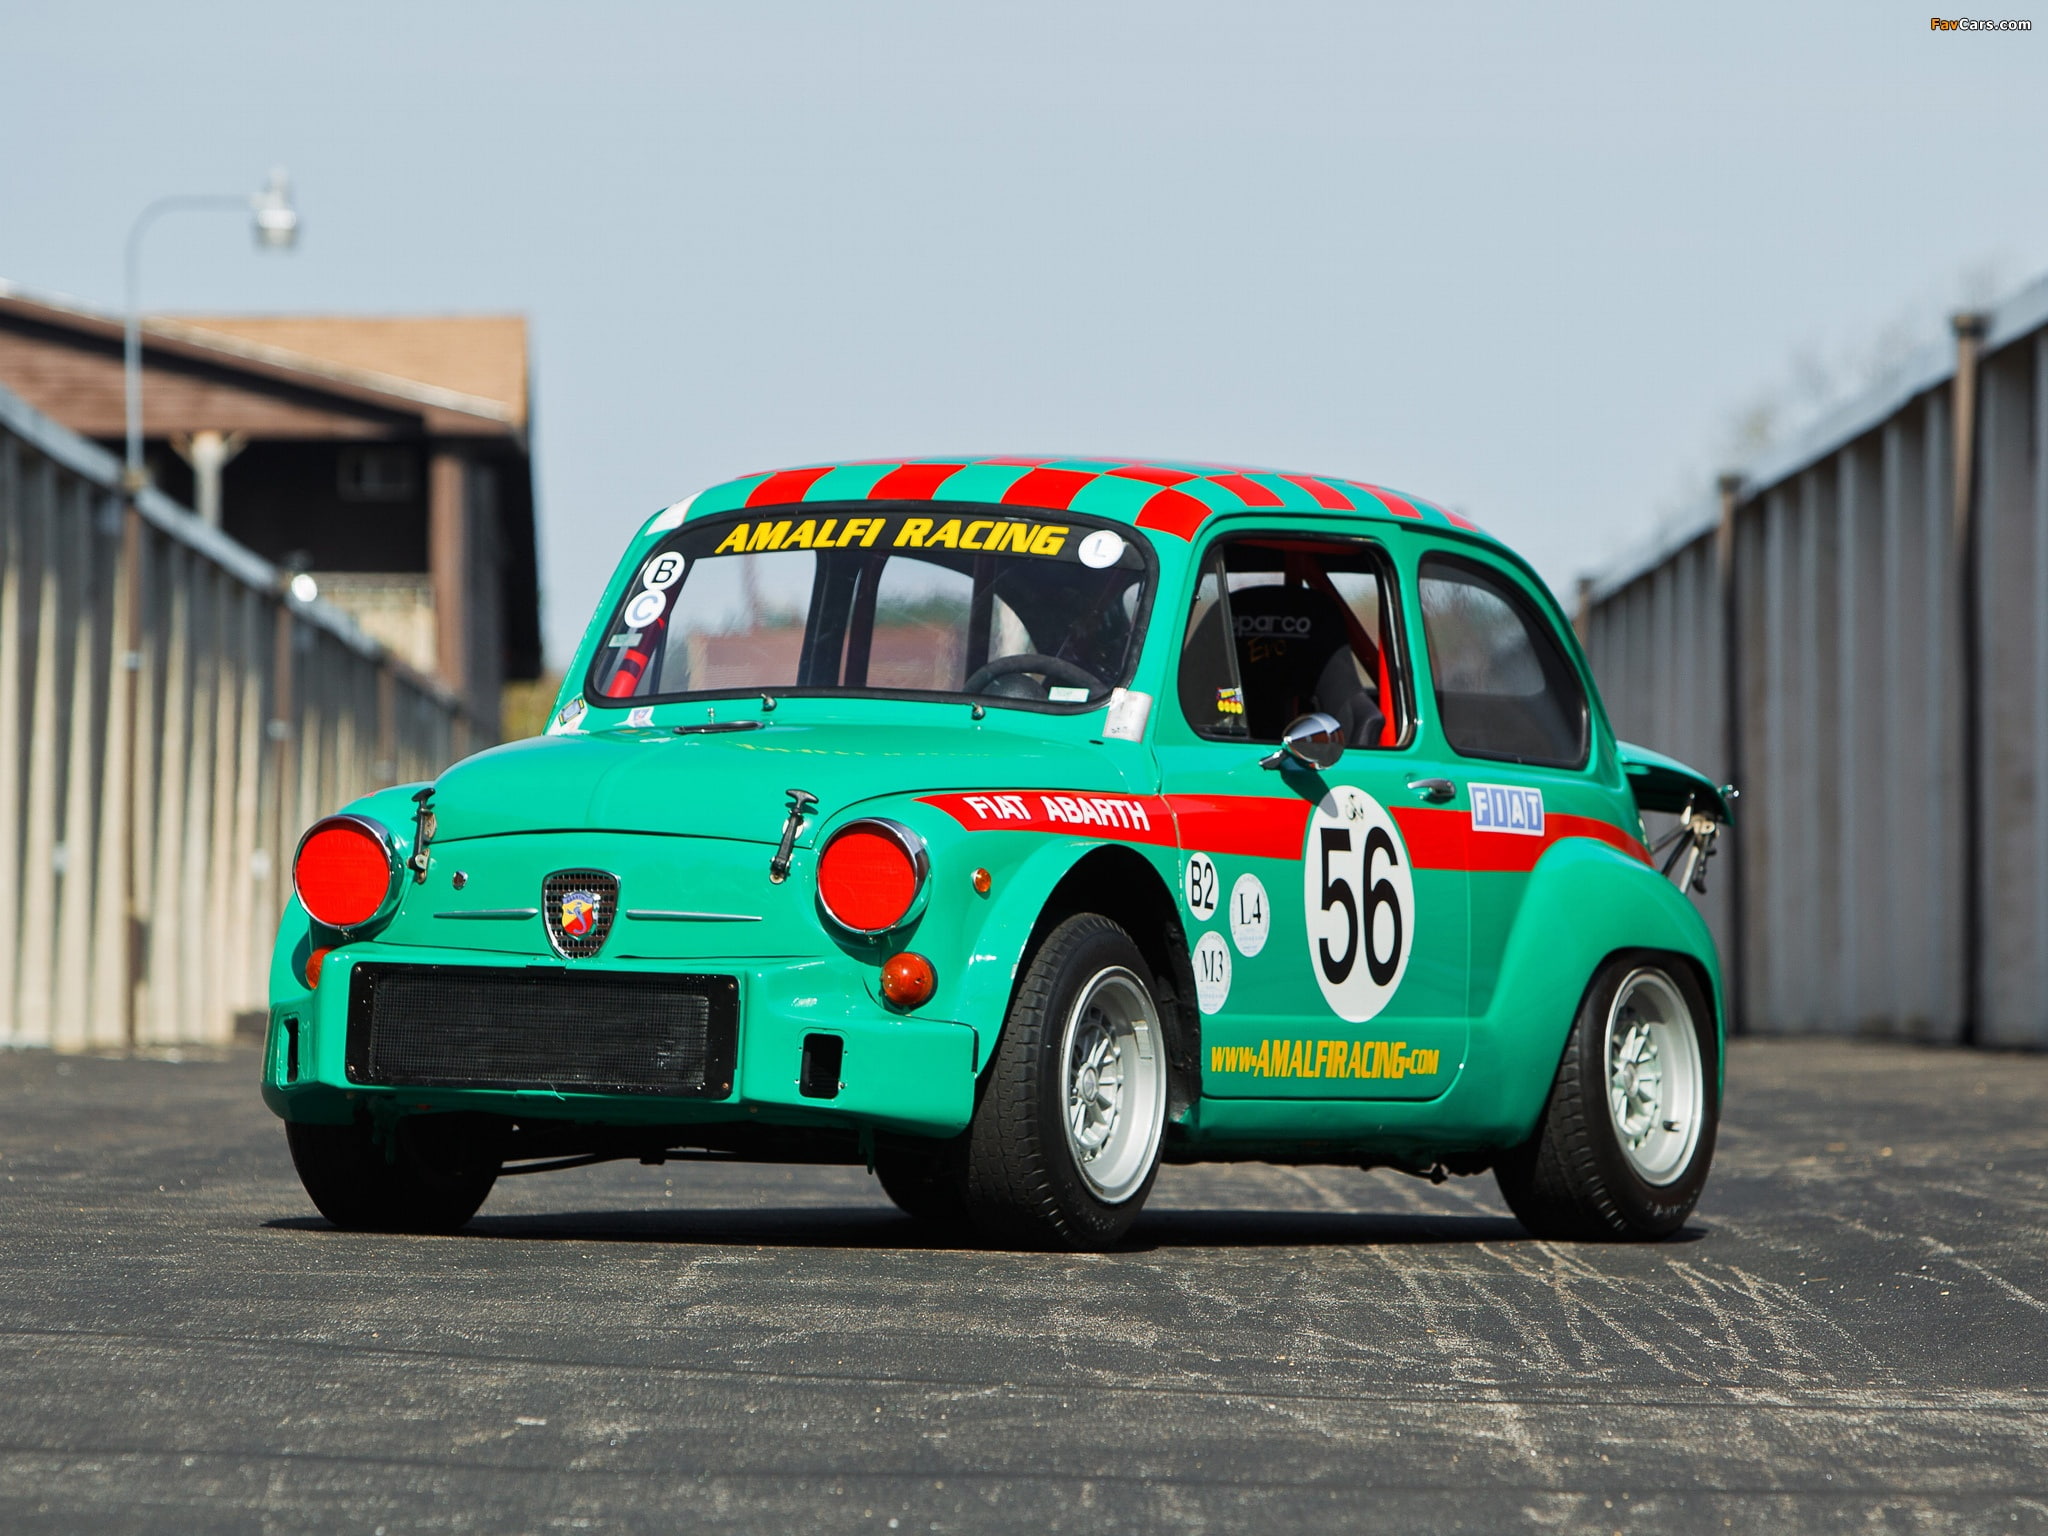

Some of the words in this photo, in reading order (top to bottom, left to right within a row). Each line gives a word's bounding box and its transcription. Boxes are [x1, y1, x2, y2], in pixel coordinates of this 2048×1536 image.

[714, 518, 886, 554] AMALFI
[893, 518, 1070, 556] RACING
[651, 559, 678, 583] B
[632, 595, 659, 621] C
[962, 795, 1032, 820] FIAT
[1040, 796, 1151, 831] ABARTH
[1473, 790, 1540, 827] FIAT
[1190, 860, 1214, 910] B2
[1239, 892, 1262, 925] L4
[1318, 826, 1403, 987] 56
[1200, 950, 1223, 983] M3
